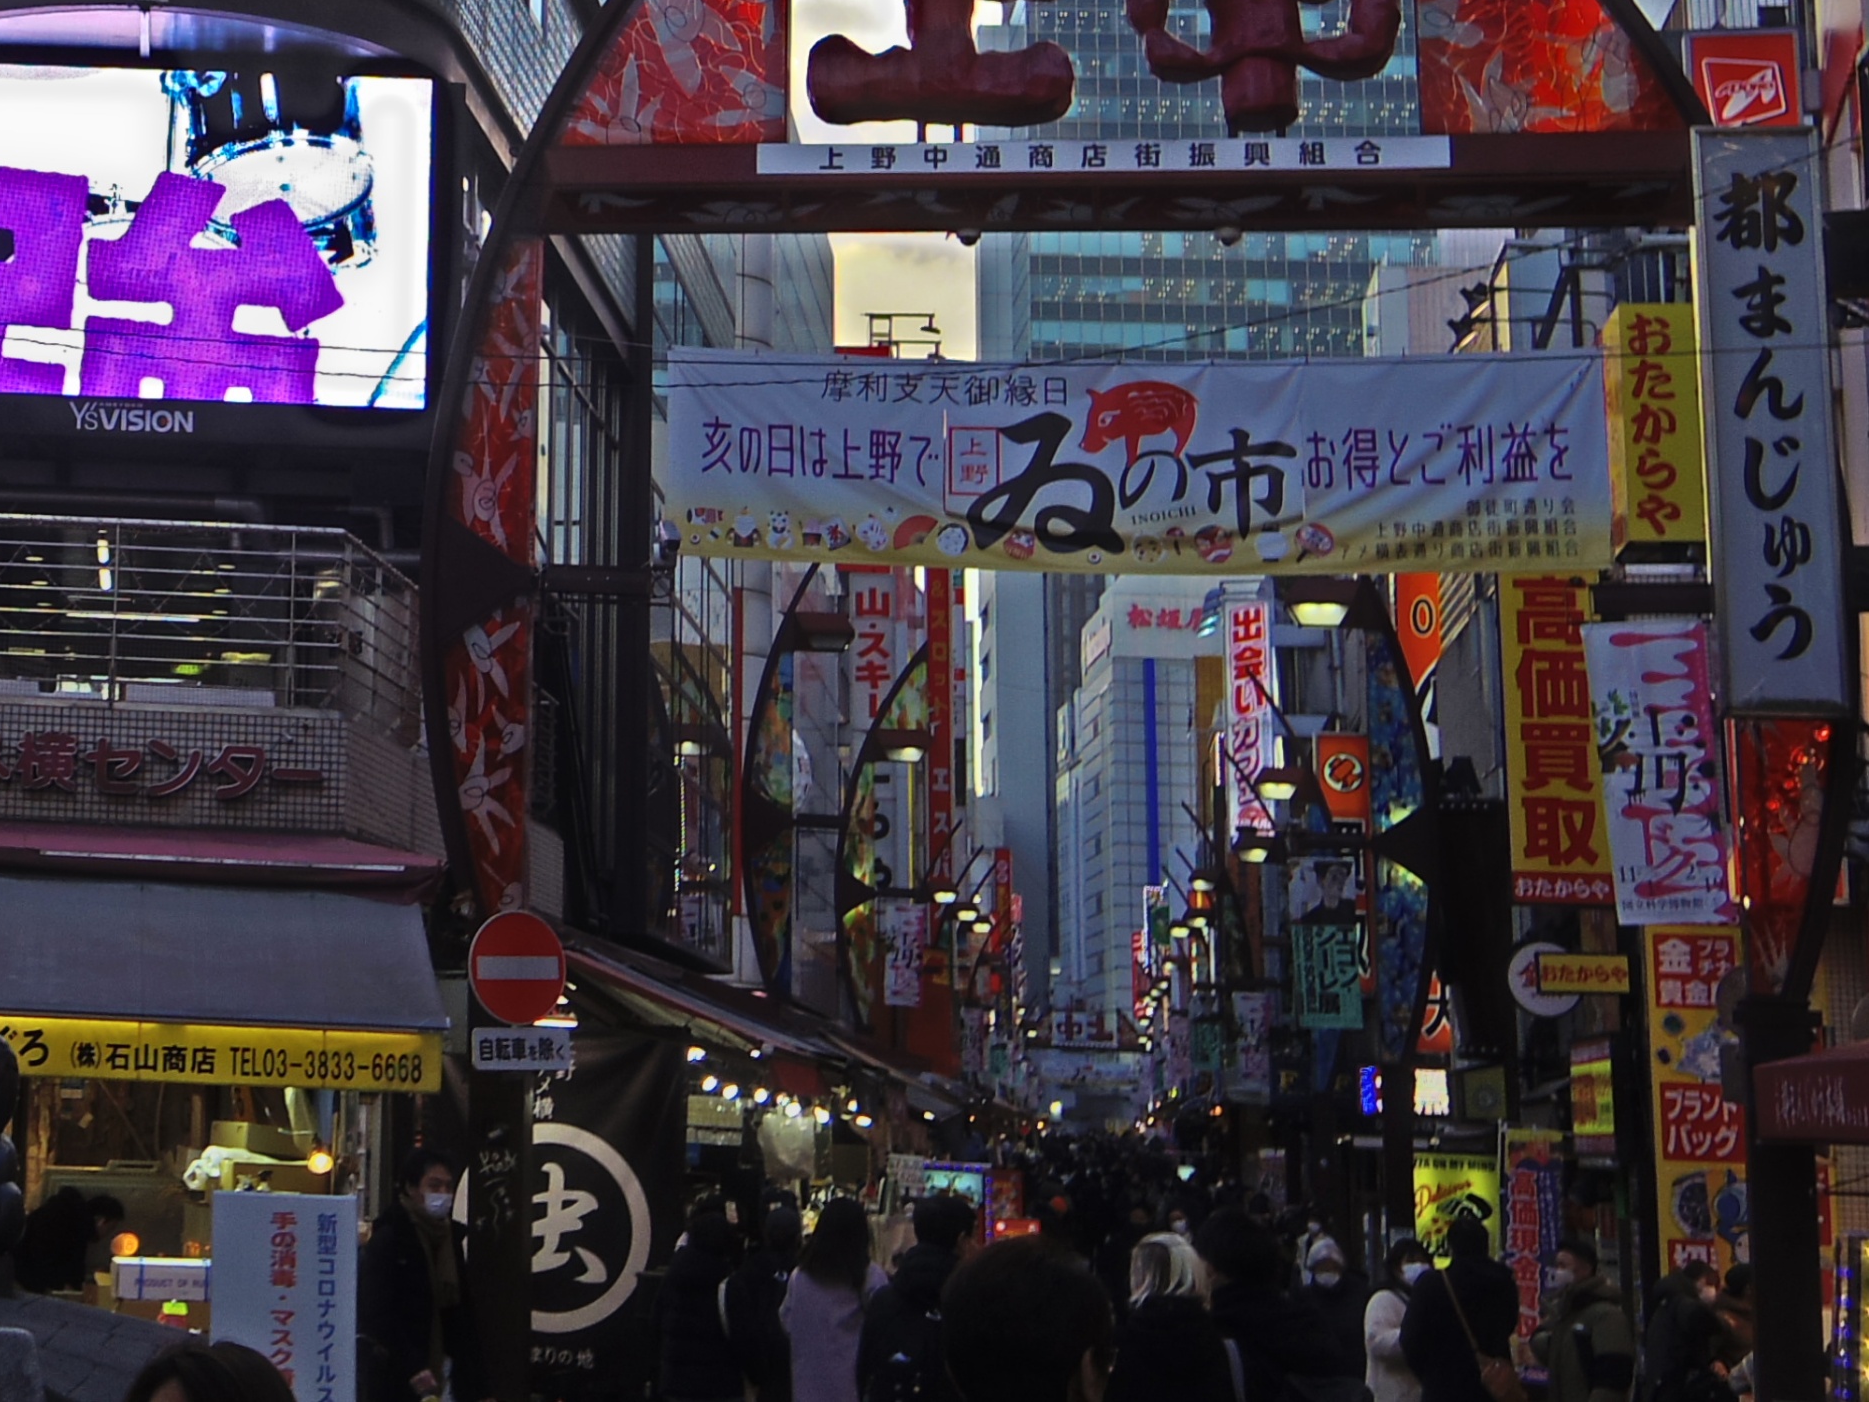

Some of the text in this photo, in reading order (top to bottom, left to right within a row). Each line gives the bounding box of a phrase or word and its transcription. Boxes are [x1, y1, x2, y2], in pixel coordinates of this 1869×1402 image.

[818, 139, 1384, 171] 上野中通商店街振興組合
[820, 370, 1068, 406] 摩利支天御縁日
[1627, 314, 1681, 535] おたからや
[1713, 170, 1813, 661] 都まんじゅう
[702, 416, 940, 487] 亥の日は上野で
[1303, 422, 1573, 491] お得とご利益を
[1513, 576, 1599, 866] 高価買取
[1515, 879, 1610, 900] おたからや
[1541, 963, 1629, 985] おたからや
[1658, 937, 1692, 975] 金
[1659, 978, 1718, 1007] 貴金
[230, 1047, 423, 1084] TEL03-3833-6668
[480, 1037, 565, 1061] 自転車を除く
[1667, 1124, 1740, 1158] バッグ
